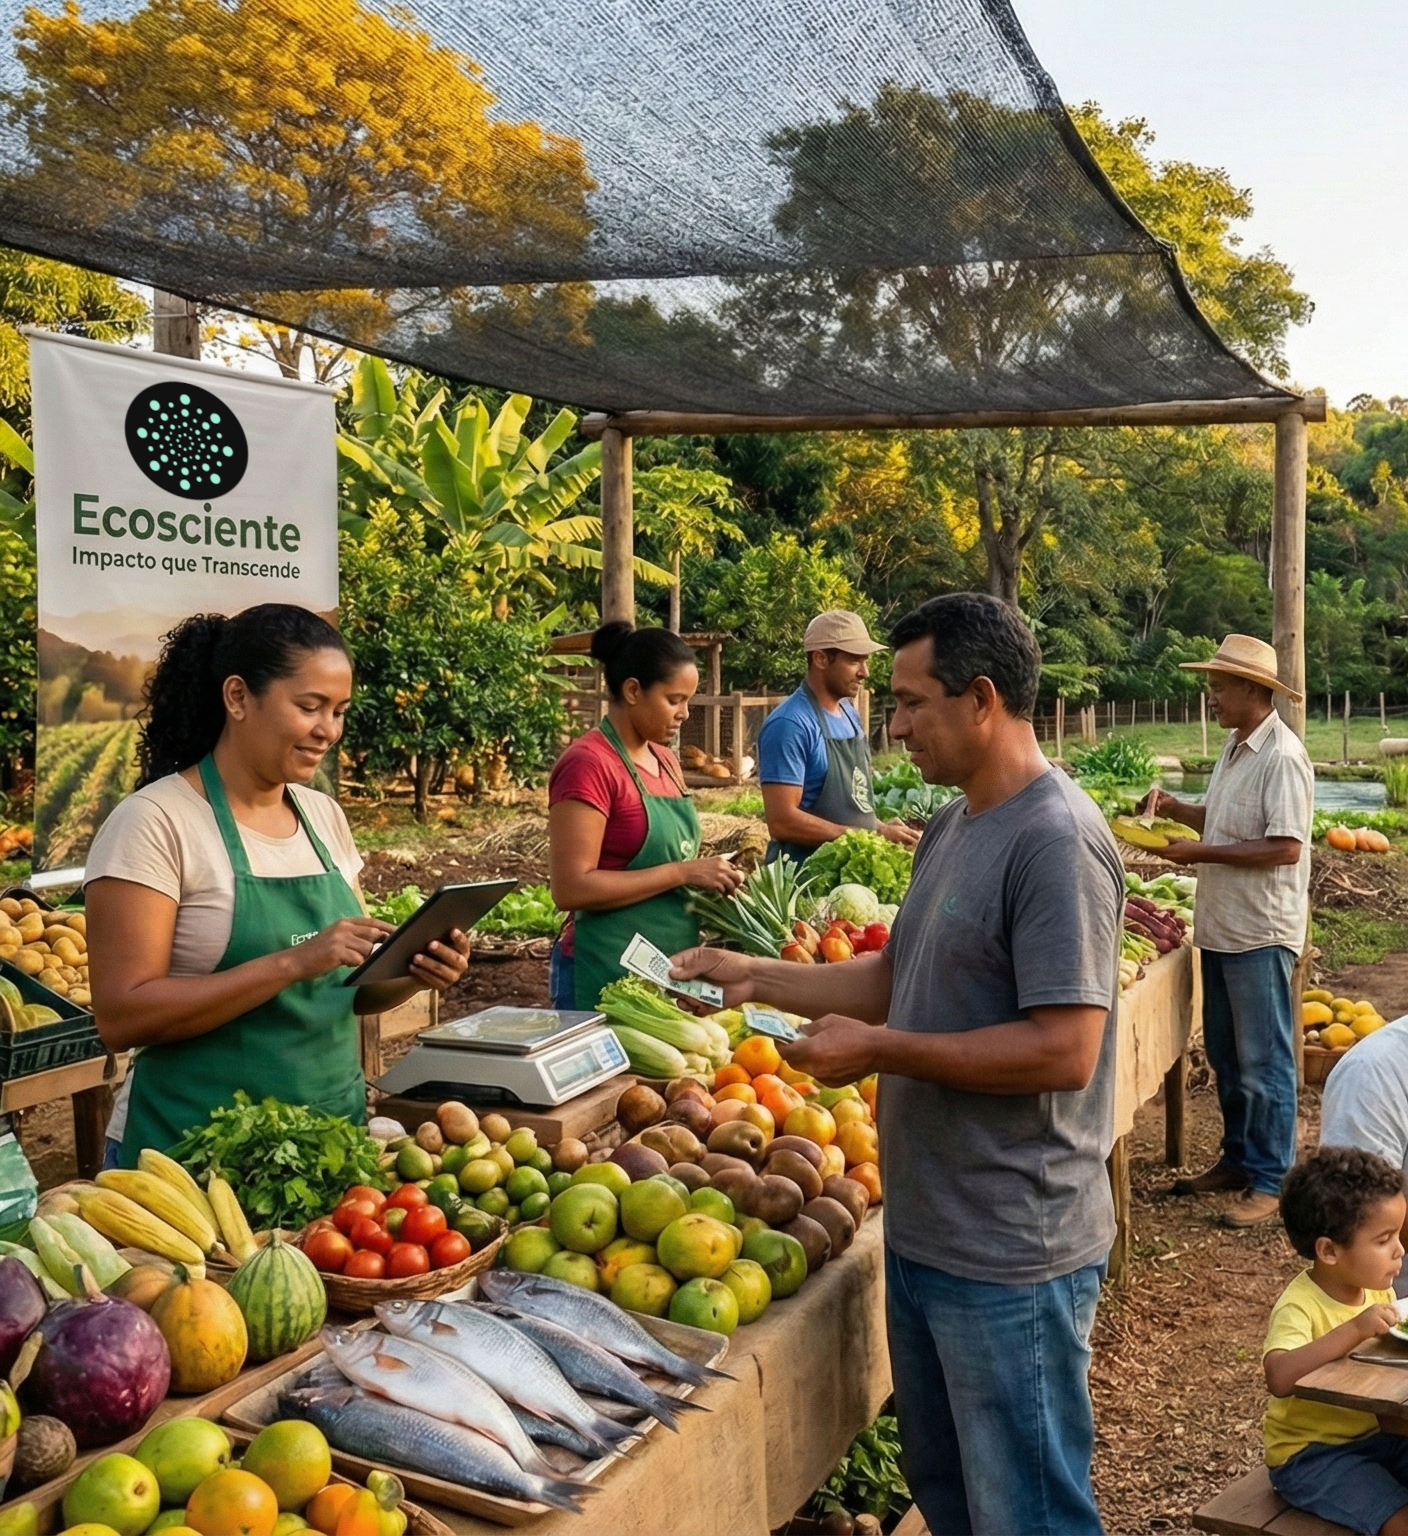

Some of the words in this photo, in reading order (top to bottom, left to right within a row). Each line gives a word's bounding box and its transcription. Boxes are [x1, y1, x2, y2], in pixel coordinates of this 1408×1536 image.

[73, 493, 301, 553] Ecosciente
[72, 546, 157, 571] Impacto
[161, 556, 197, 576] que
[201, 556, 301, 579] Transcende
